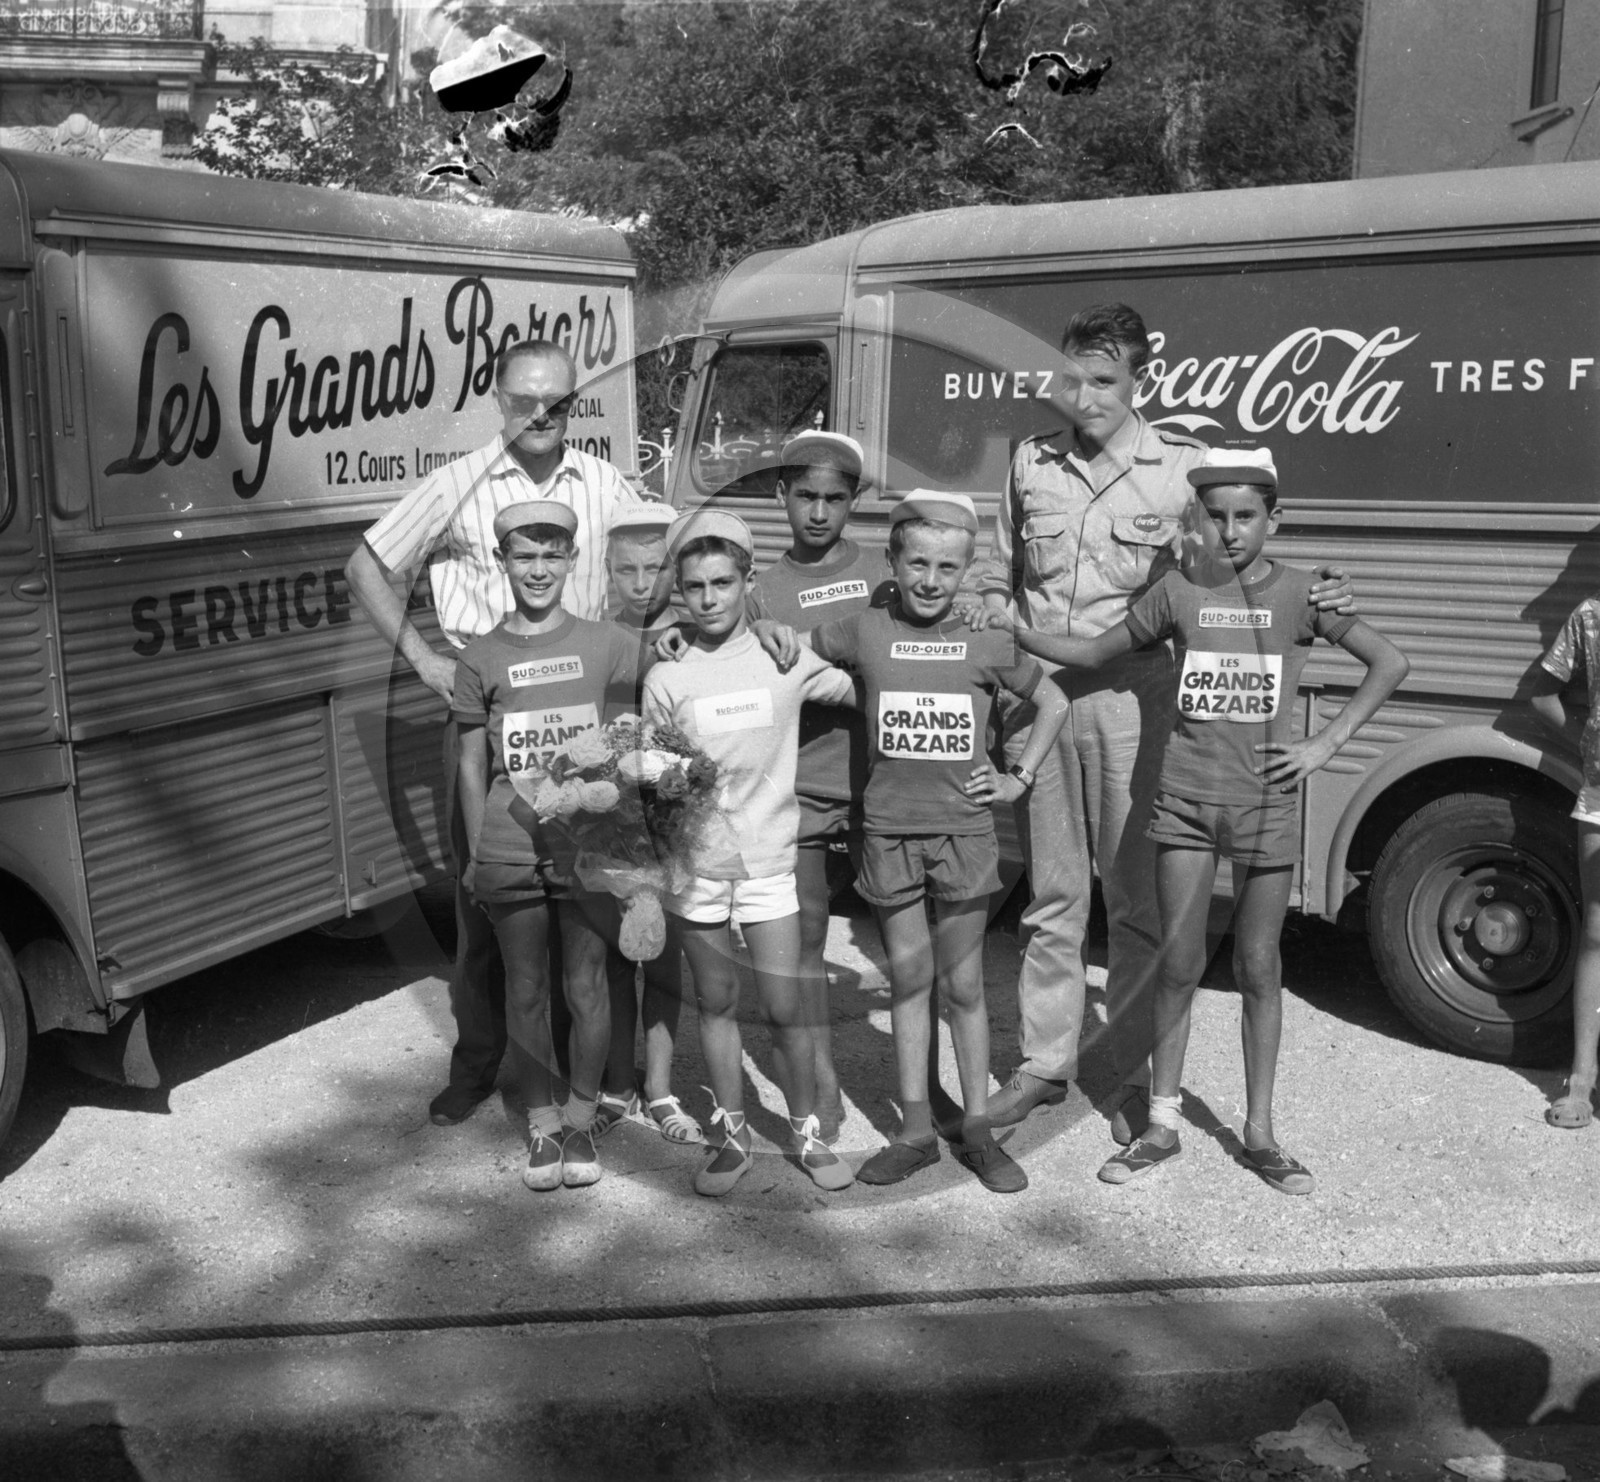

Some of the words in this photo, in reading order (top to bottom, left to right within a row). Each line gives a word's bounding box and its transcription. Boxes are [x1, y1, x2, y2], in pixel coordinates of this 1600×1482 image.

[944, 370, 1054, 399] BUVEZ
[1430, 358, 1546, 392] TRES
[104, 312, 221, 477] Les
[232, 297, 435, 499] Grands
[569, 397, 605, 418] OCIAL
[800, 583, 864, 602] SUD-OUEST
[131, 568, 352, 657] SERVICE
[1200, 612, 1269, 623] SUD-OUEST
[895, 644, 964, 654] SUD-OUEST
[511, 661, 579, 679] SUD-OUEST
[1220, 658, 1239, 668] LES
[1184, 671, 1275, 691] GRANDS
[716, 702, 759, 715] SUD-OUEST
[916, 697, 935, 707] LES
[1181, 693, 1274, 714] BAZARS
[543, 713, 563, 724] LES
[882, 710, 972, 730] GRANDS
[507, 723, 594, 749] GRAND
[882, 732, 970, 753] BAZARS
[509, 751, 555, 772] BAZ
